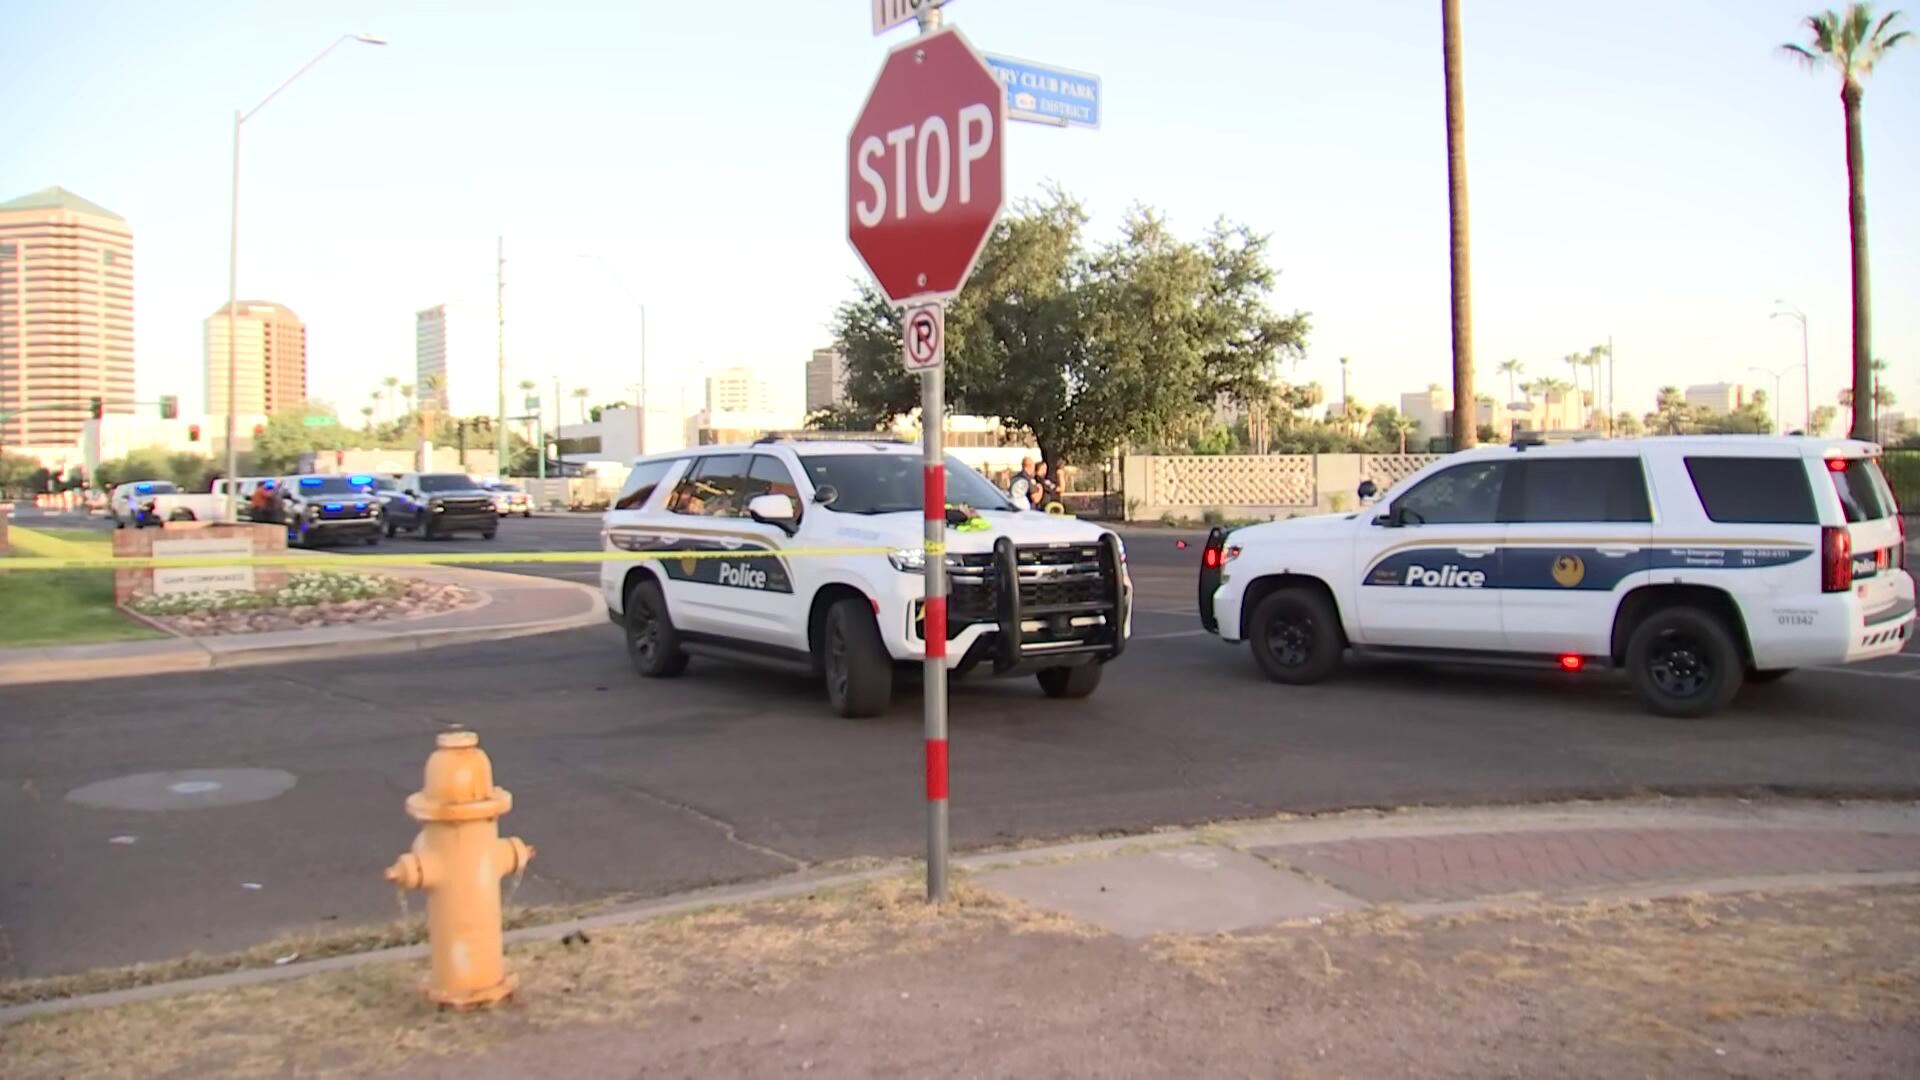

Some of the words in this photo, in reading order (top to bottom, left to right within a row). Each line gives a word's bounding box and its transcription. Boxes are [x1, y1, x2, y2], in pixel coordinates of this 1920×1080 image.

[1021, 71, 1058, 93] CLUB
[1060, 79, 1097, 101] PARK
[1041, 97, 1090, 120] DISTRICT
[856, 102, 994, 228] STOP
[719, 562, 767, 588] Police
[1405, 564, 1486, 587] Police
[1852, 557, 1875, 577] Police
